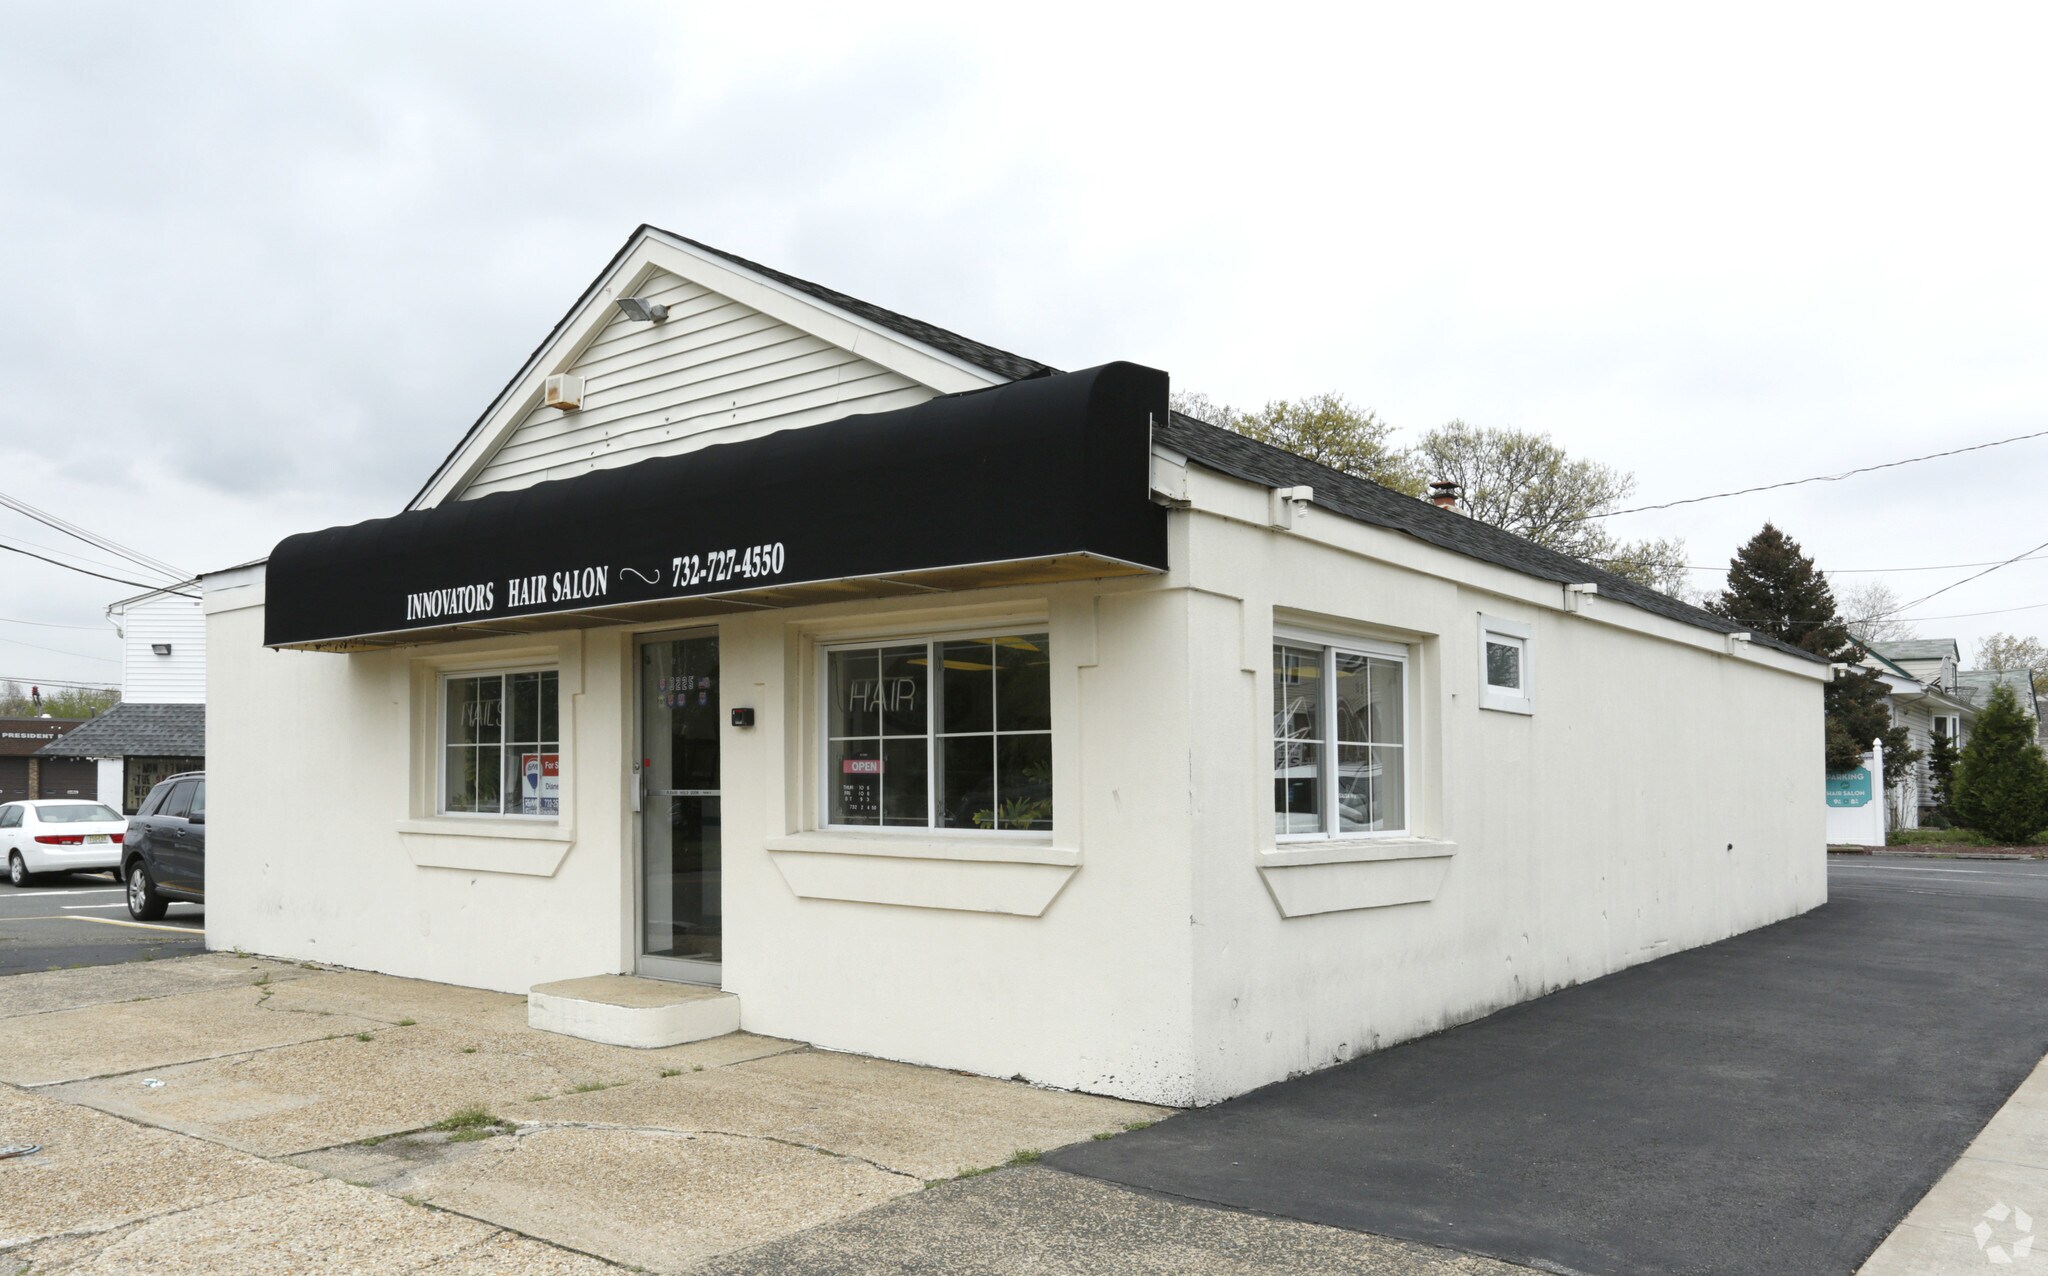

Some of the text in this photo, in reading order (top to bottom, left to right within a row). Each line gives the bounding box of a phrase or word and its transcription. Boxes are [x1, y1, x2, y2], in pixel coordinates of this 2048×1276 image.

[406, 542, 785, 620] INNOVATORS HAIR SALON 732-727-4550
[849, 678, 916, 712] HAIR
[851, 762, 877, 771] OPEN
